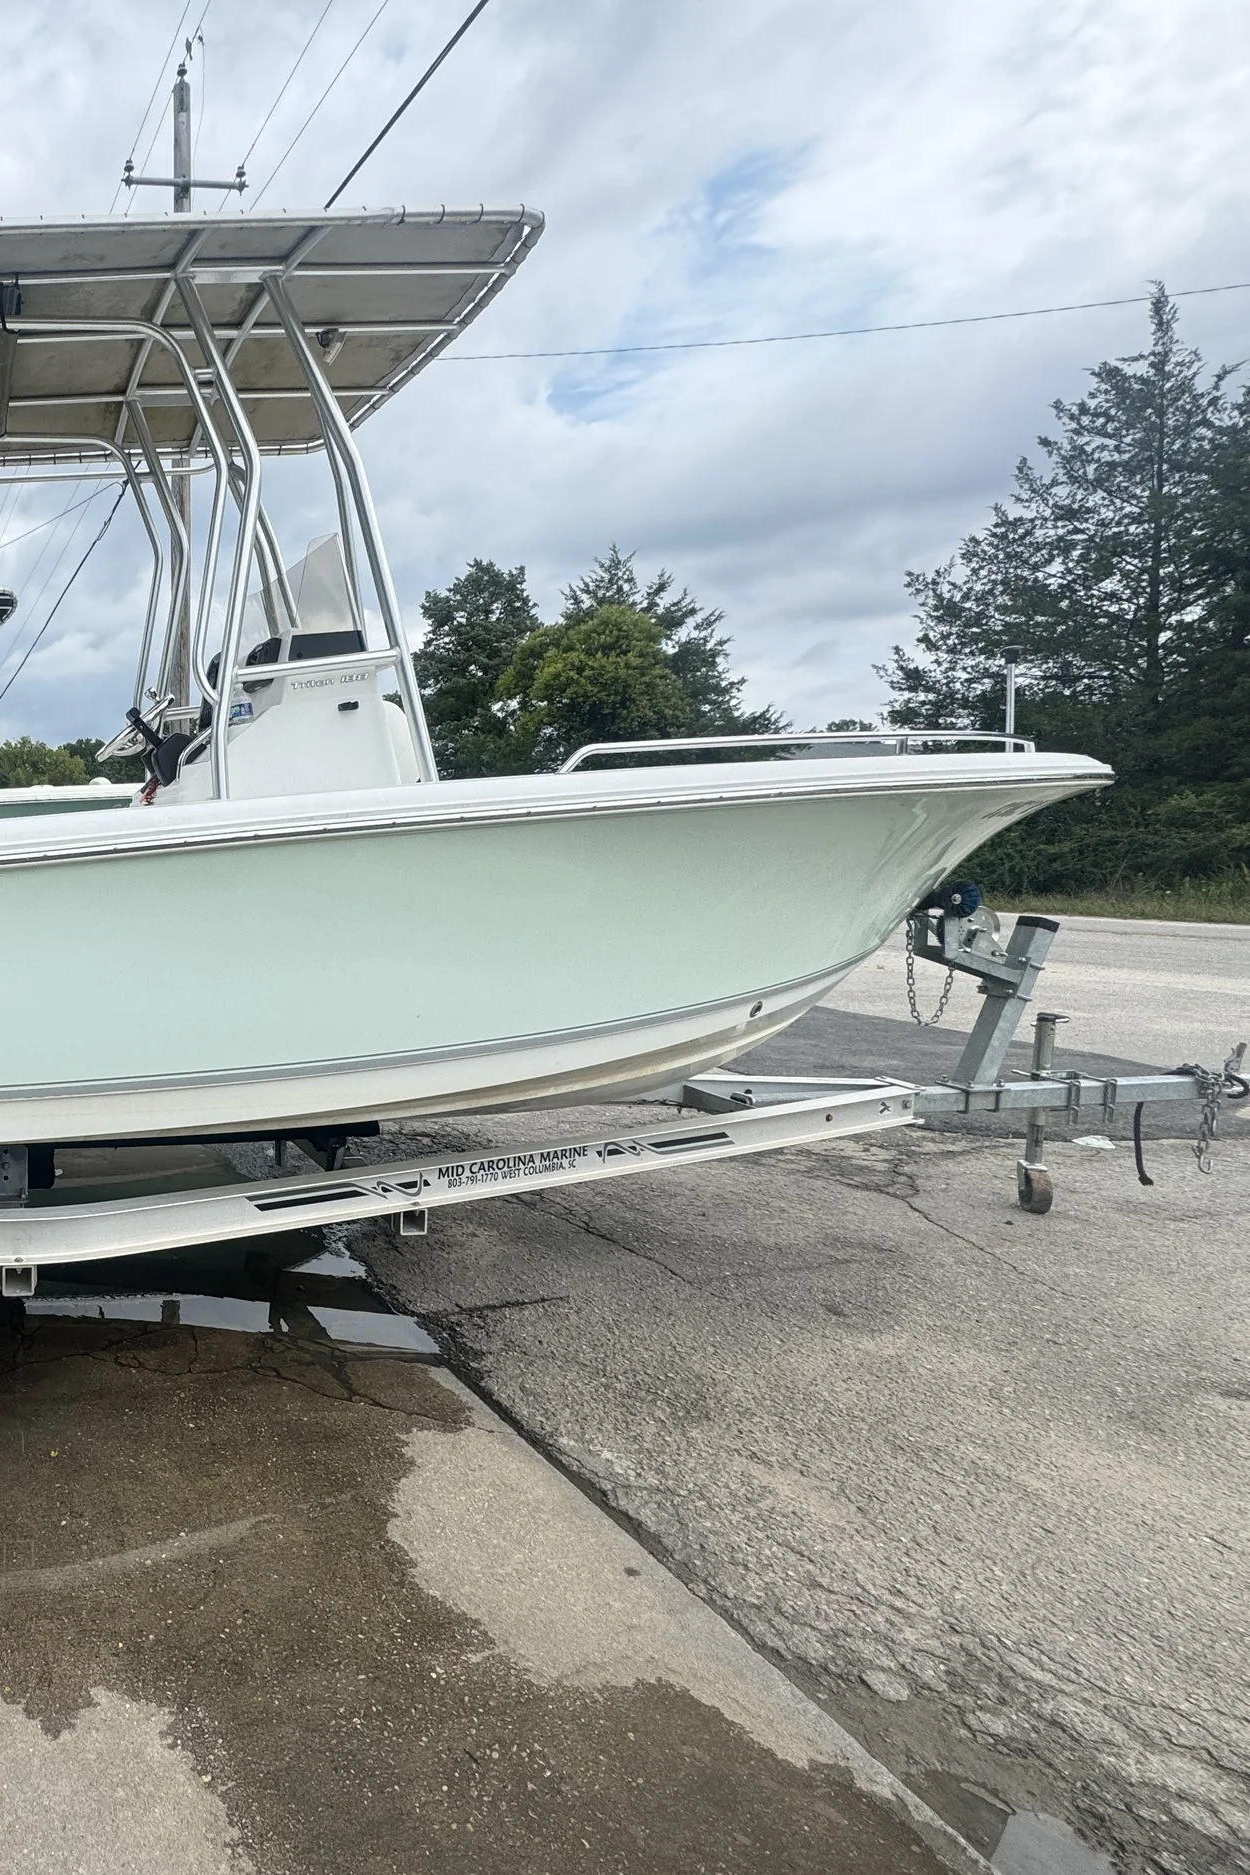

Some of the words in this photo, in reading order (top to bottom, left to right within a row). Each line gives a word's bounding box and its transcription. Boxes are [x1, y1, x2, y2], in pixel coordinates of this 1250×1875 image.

[291, 679, 335, 690] Triton
[437, 1165, 465, 1180] MID
[469, 1154, 536, 1174] CAROLINA
[540, 1145, 589, 1164] MARINE
[447, 1171, 499, 1189] 803-791-1770
[500, 1168, 522, 1180] WEST
[523, 1161, 567, 1177] COLUMBIA,
[568, 1159, 577, 1169] SC
